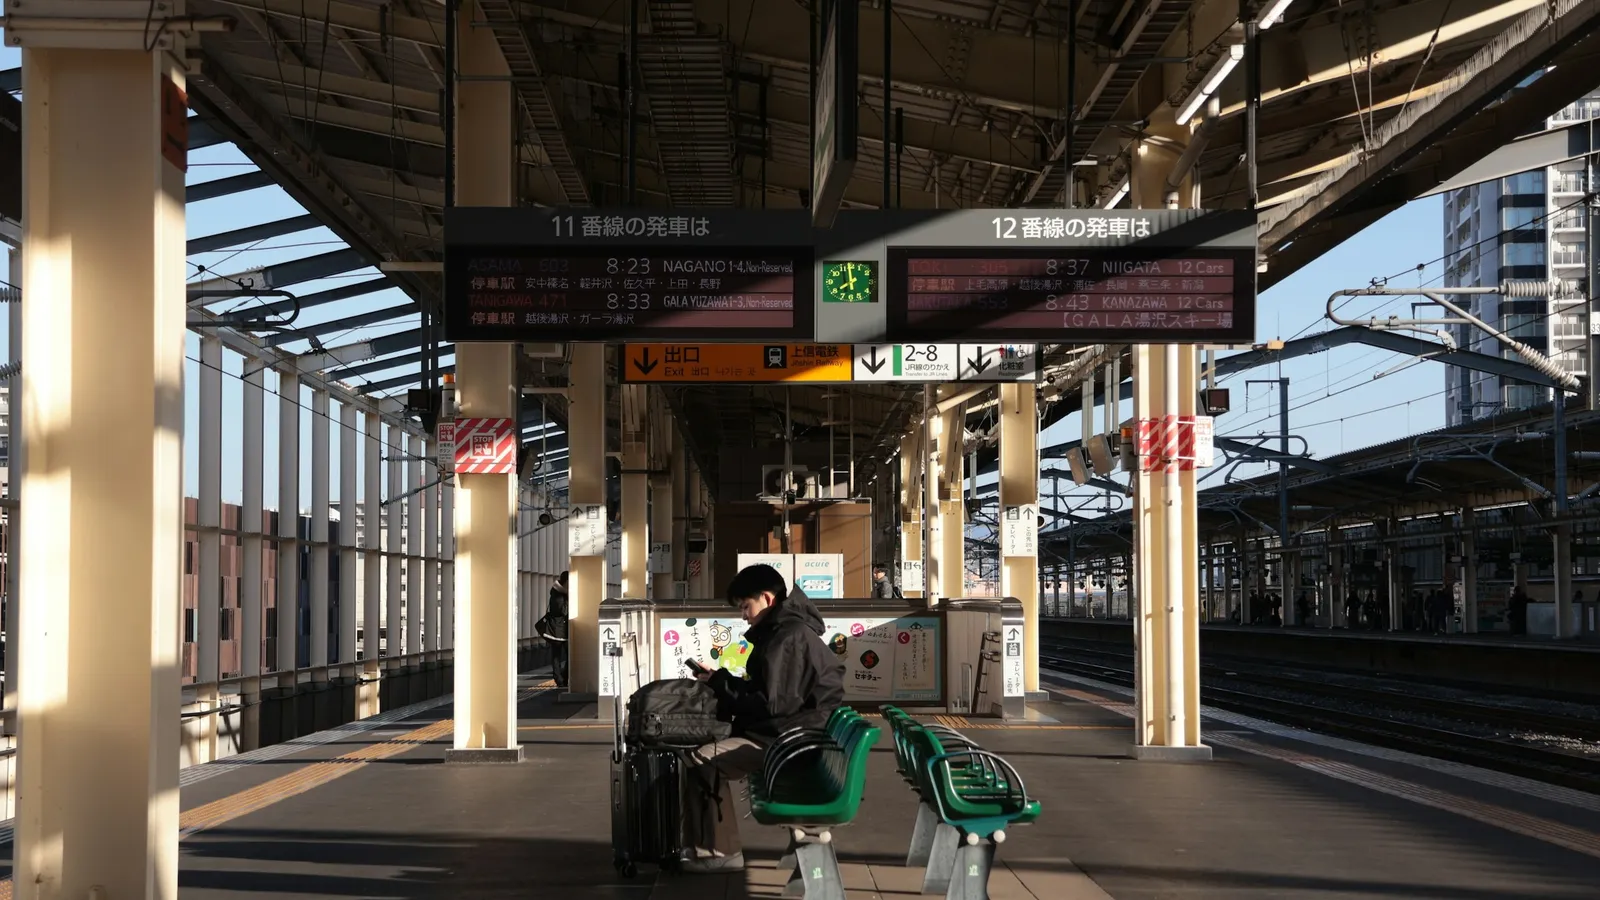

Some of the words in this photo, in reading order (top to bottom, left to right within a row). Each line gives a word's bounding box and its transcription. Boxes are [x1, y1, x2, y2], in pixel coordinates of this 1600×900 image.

[468, 259, 523, 272] ASAMA
[539, 258, 569, 272] 603
[607, 258, 650, 274] 8:23
[664, 260, 726, 272] NAGANO
[912, 261, 946, 272] TOKI
[1046, 259, 1090, 275] 8:37
[1103, 261, 1160, 273] NIIGATA
[1179, 261, 1192, 273] 12
[1196, 262, 1224, 273] Cars
[471, 276, 516, 290] 停車駅
[912, 278, 956, 291] 停車駅
[468, 294, 533, 306] TANIGAWA
[539, 294, 568, 308] 471
[607, 294, 650, 310] 8:33
[664, 296, 689, 308] GALA
[690, 296, 728, 308] YUZAWA
[908, 296, 972, 310] HAKUTAKA
[980, 296, 1008, 310] 553
[1046, 294, 1090, 310] 8:43
[1102, 296, 1168, 309] KANAZAWA
[1178, 296, 1192, 308] 12
[1196, 297, 1224, 309] Cars
[471, 312, 516, 325] 停車駅
[664, 346, 700, 363] 出口
[792, 346, 839, 358] 上信電鉄
[664, 366, 684, 376] Exit
[692, 367, 709, 376] 出口
[999, 362, 1024, 370] 化粧室
[666, 632, 678, 644] よ
[855, 673, 882, 681] セキチュー
